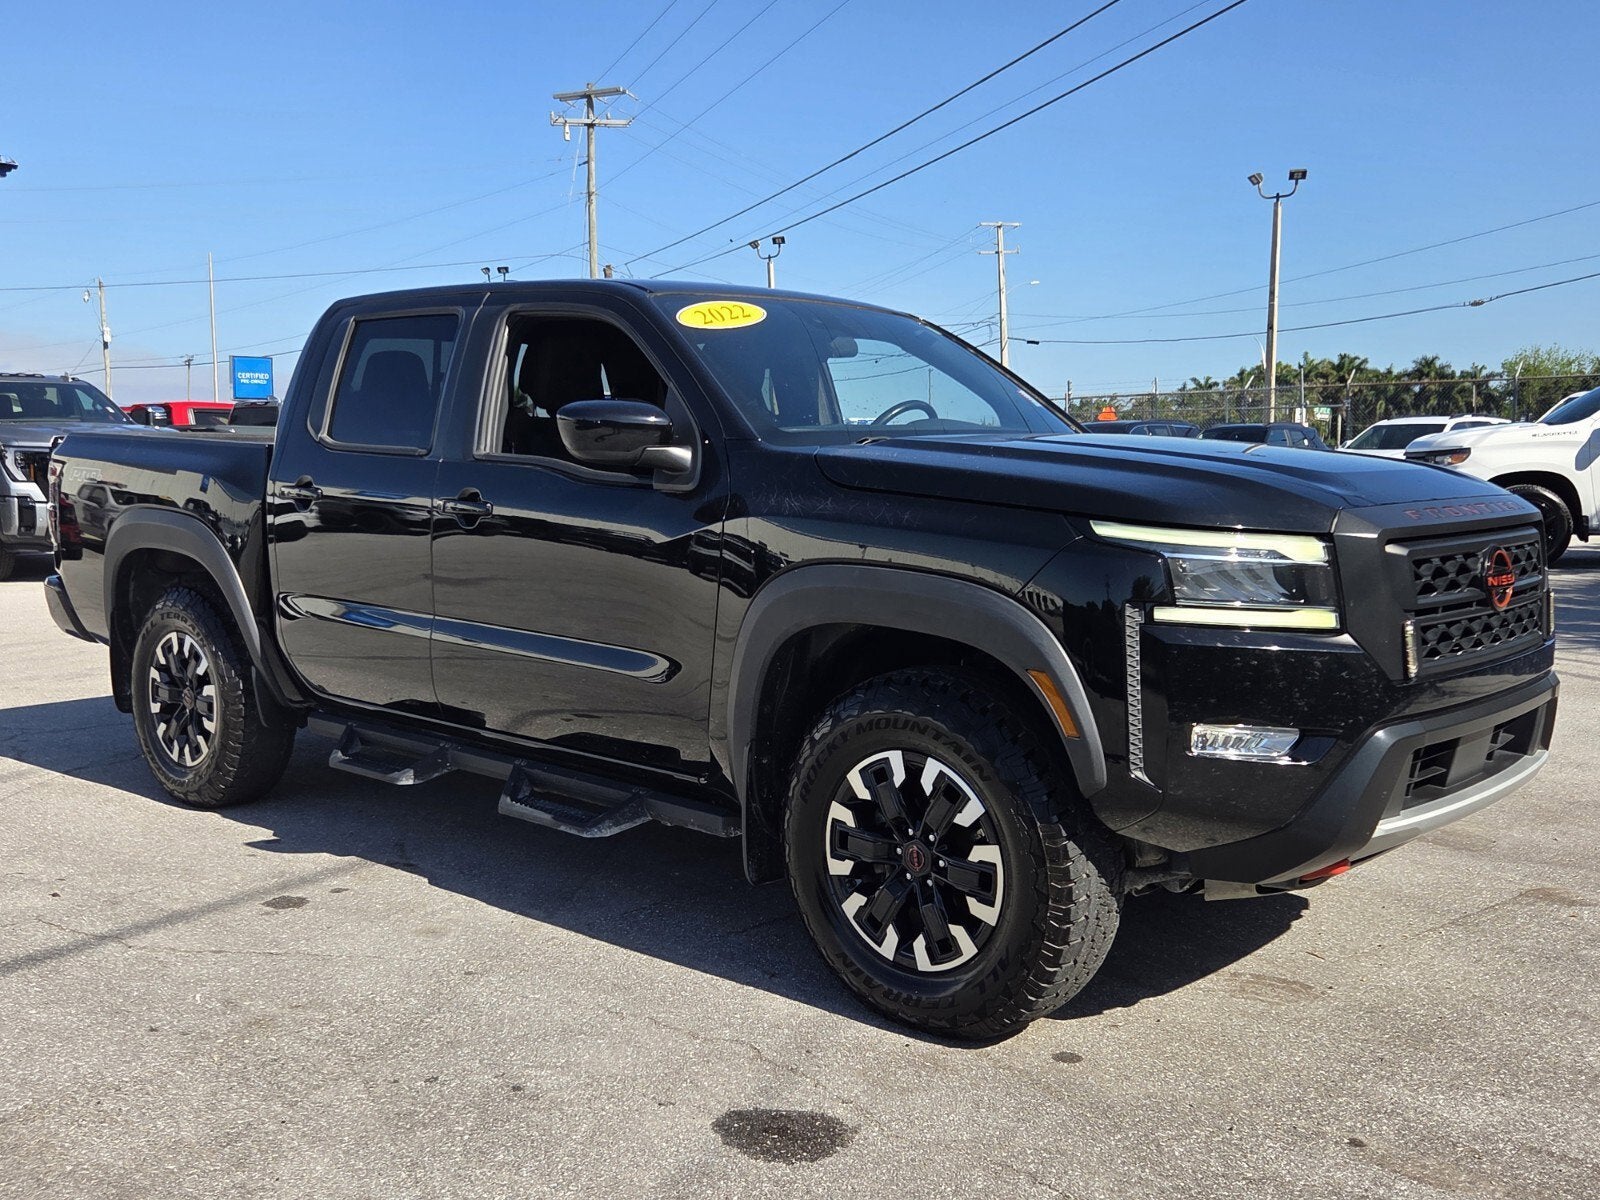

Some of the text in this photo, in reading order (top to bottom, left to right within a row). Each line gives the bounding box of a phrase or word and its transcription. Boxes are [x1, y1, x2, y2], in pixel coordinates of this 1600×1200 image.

[694, 304, 751, 325] 2022
[237, 372, 270, 380] CERTIFIED
[1487, 574, 1515, 587] NISS
[854, 716, 994, 783] MOUNTAIN
